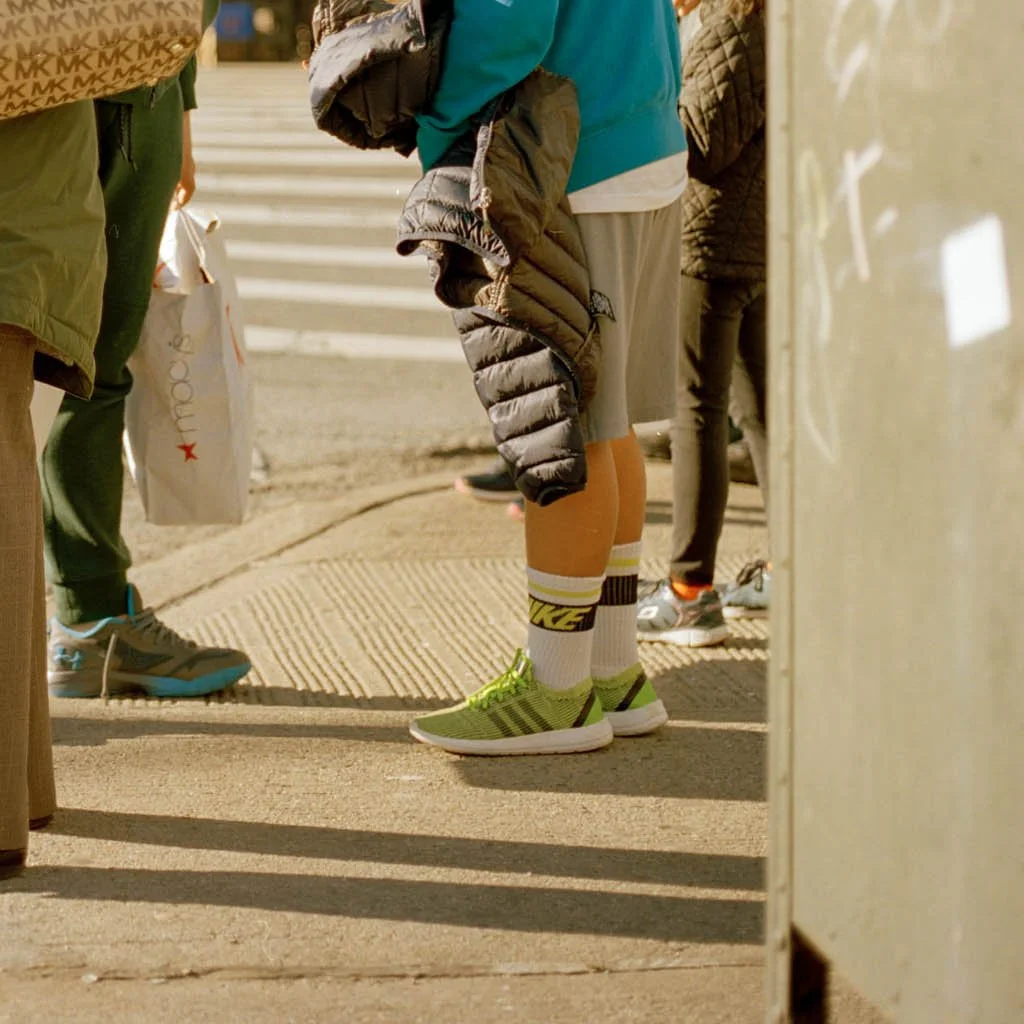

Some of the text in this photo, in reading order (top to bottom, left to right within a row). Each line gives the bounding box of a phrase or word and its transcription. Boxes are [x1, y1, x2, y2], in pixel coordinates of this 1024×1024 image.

[32, 12, 74, 34] MK
[73, 5, 113, 29] MK
[114, 2, 155, 24] MK
[15, 57, 51, 81] MK
[57, 53, 93, 75] MK
[98, 46, 133, 69] MK
[137, 40, 174, 61] MK
[31, 77, 67, 97] MK
[72, 71, 109, 90] MK
[112, 63, 147, 81] MK
